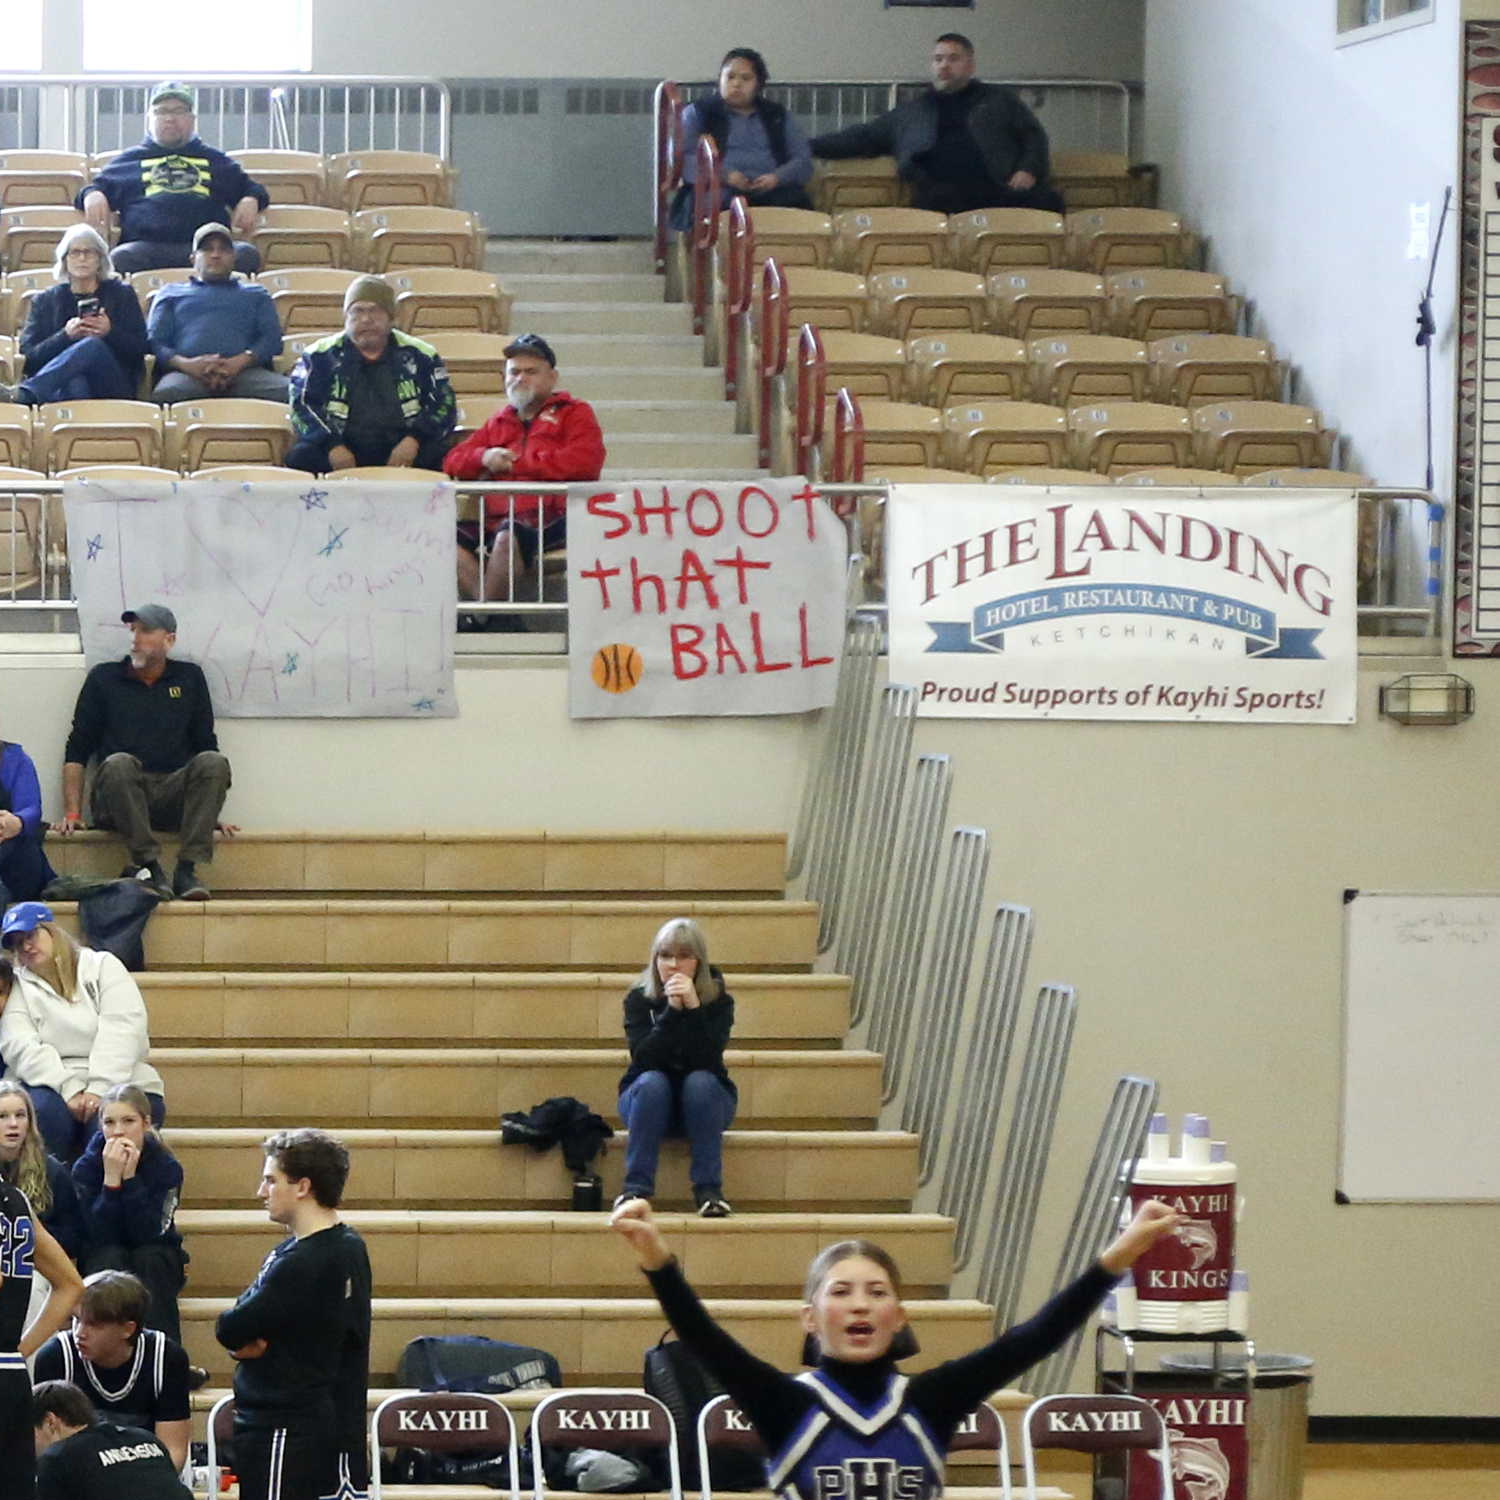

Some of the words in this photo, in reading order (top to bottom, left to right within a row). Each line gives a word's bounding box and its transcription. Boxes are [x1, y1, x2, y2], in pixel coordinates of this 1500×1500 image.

[911, 517, 1040, 606] THE
[985, 593, 1058, 628] HOTEL,
[1063, 586, 1198, 616] RESTAURANT
[1203, 598, 1219, 617] &
[1222, 605, 1263, 630] PUB
[670, 603, 836, 680] BALL
[1030, 623, 1226, 651] KETCHIKAN
[920, 681, 998, 704] Proud
[1002, 682, 1118, 709] Supports
[1125, 683, 1154, 706] of
[1157, 684, 1230, 714] Kayhi
[1234, 686, 1327, 713] Sports!
[1149, 1269, 1228, 1289] KINGS
[397, 1410, 490, 1431] KAYHI
[556, 1409, 651, 1430] KAYHI
[1047, 1410, 1143, 1432] KAYHI
[98, 1442, 165, 1467] ANDERSON
